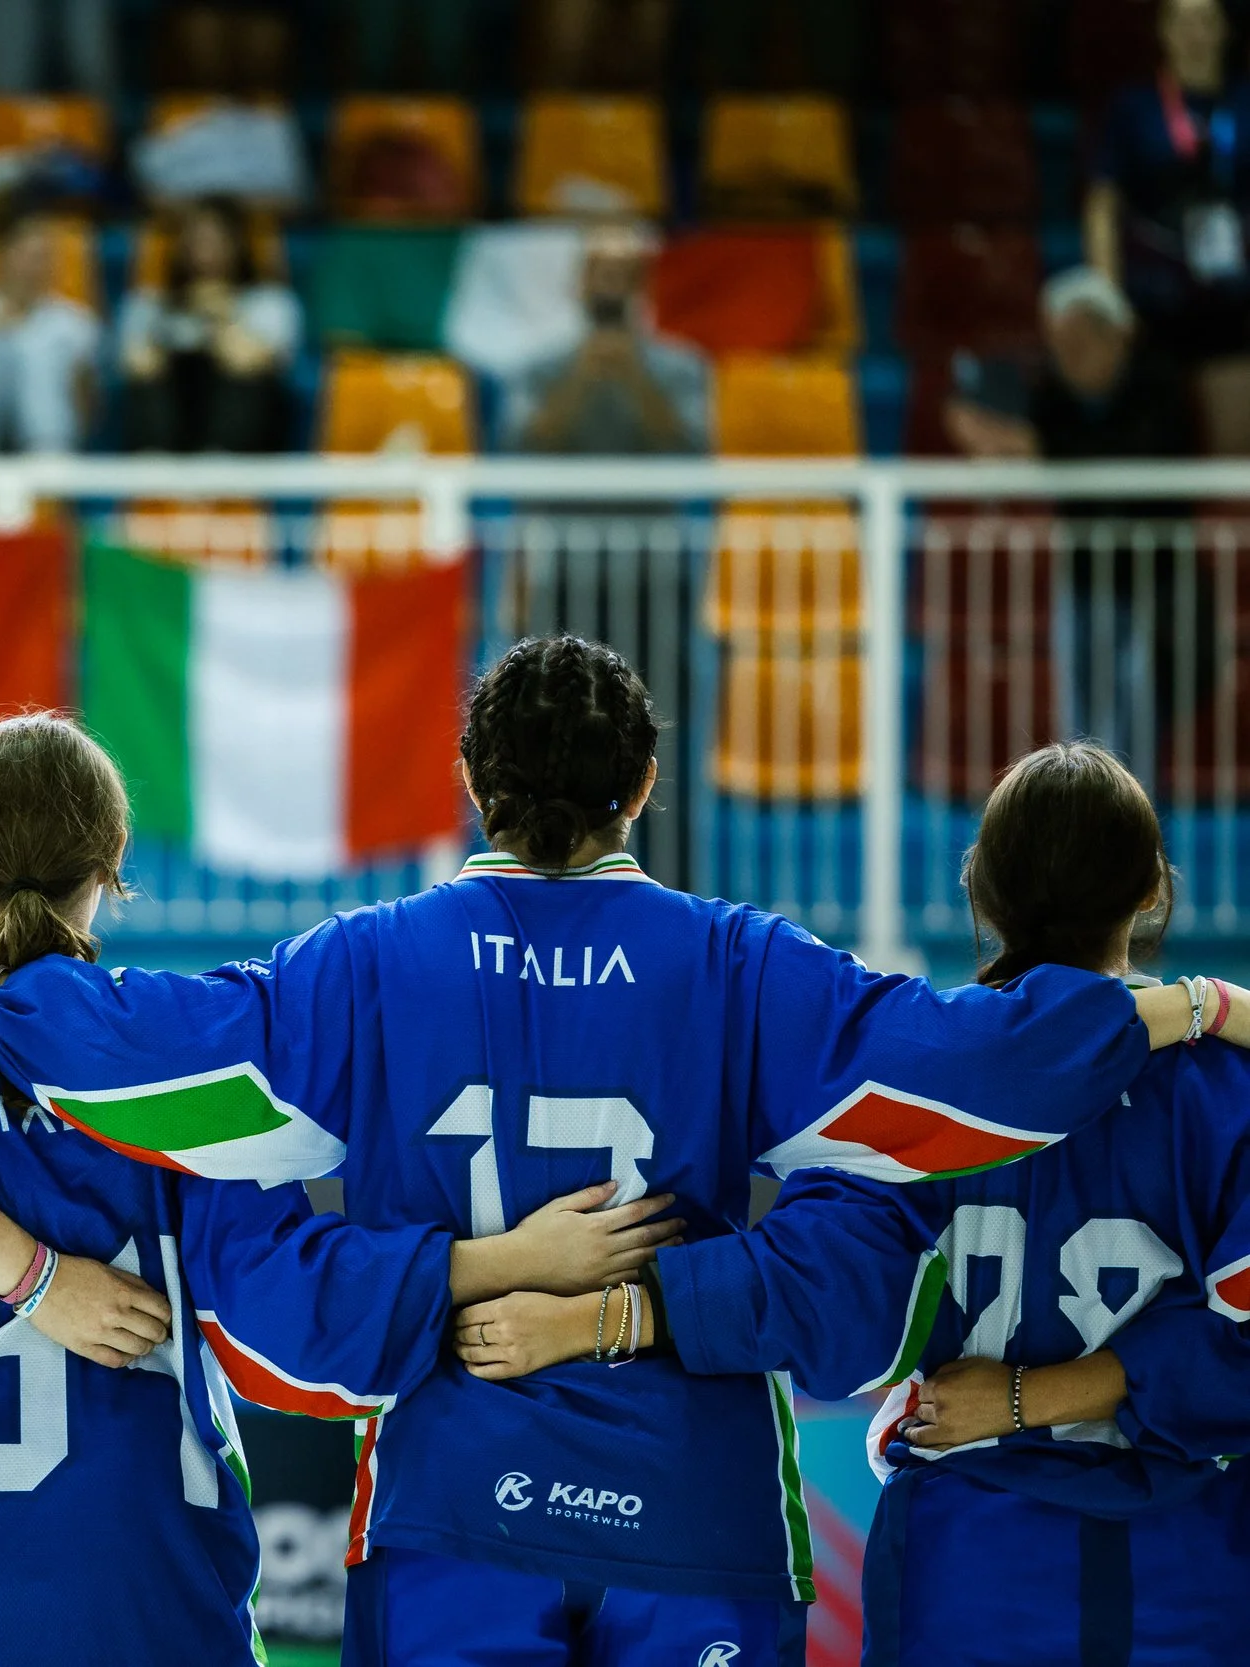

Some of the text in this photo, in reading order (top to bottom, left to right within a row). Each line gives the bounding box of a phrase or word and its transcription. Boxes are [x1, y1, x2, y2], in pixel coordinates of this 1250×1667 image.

[470, 931, 636, 987] ITALIA
[547, 1482, 643, 1516] KAPO
[546, 1507, 640, 1530] SPORTSWEAR
